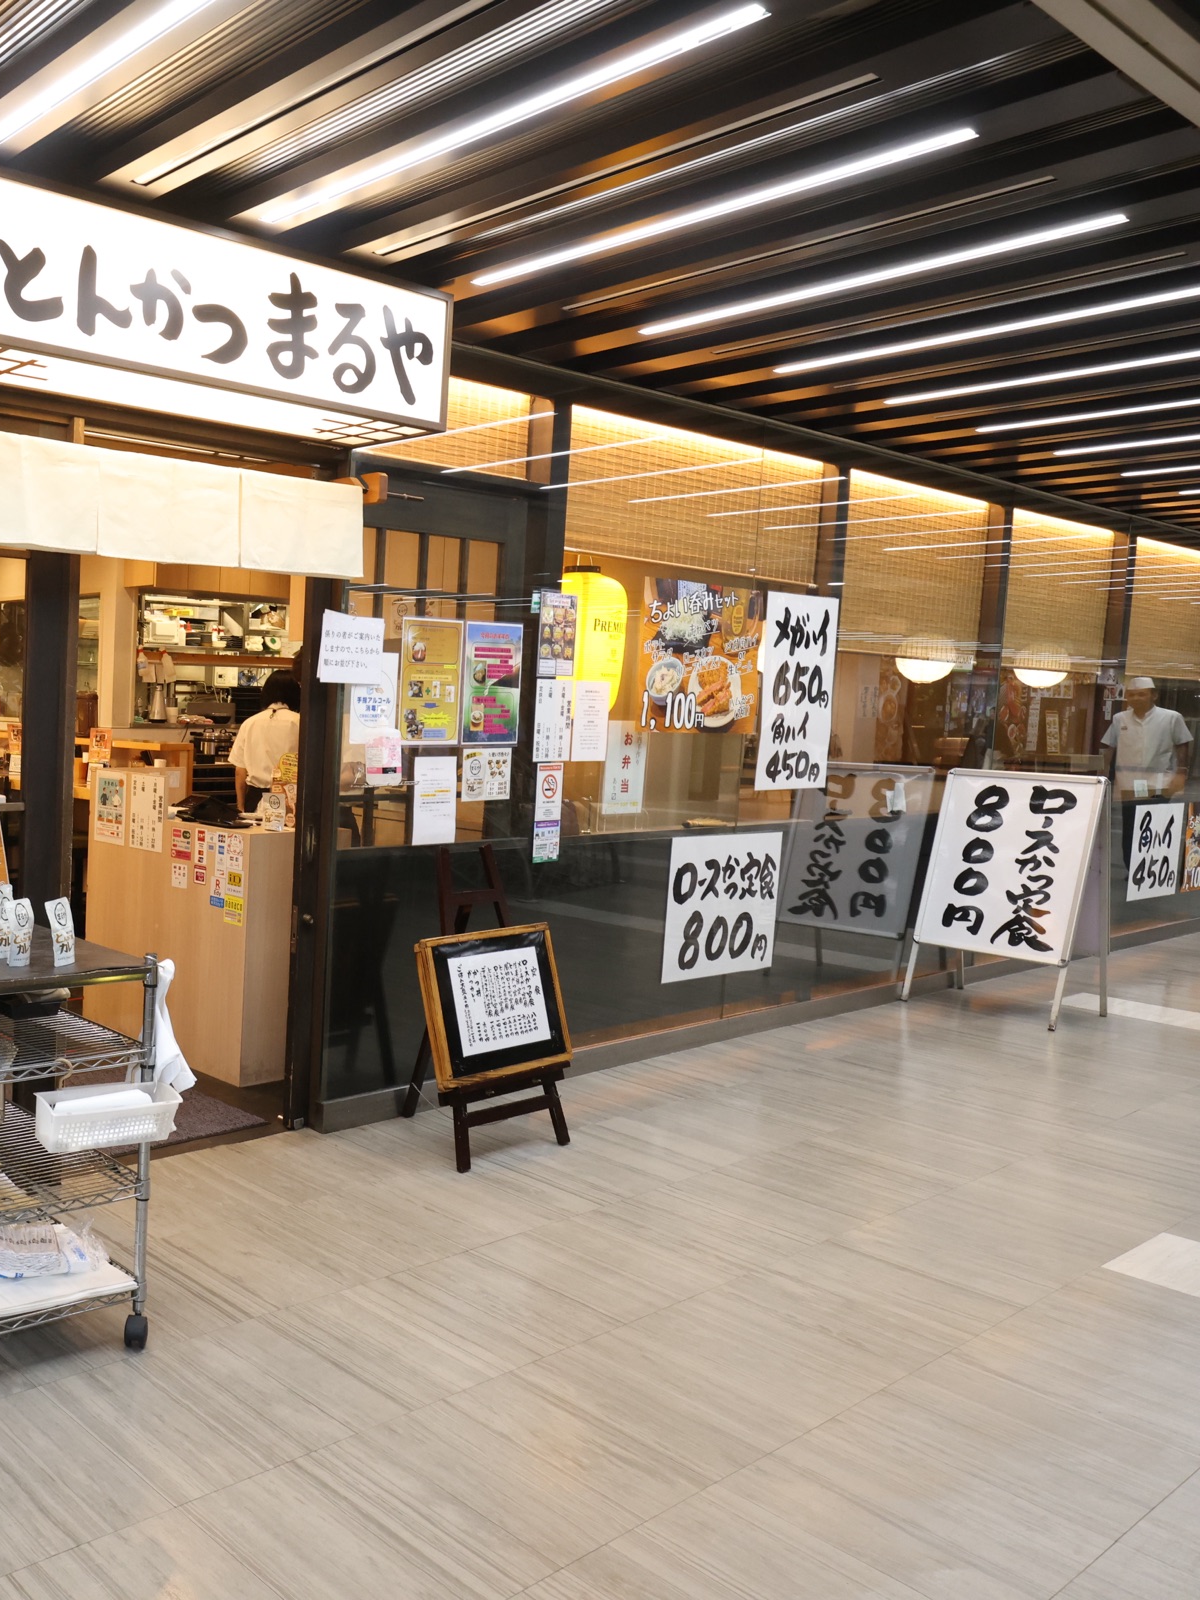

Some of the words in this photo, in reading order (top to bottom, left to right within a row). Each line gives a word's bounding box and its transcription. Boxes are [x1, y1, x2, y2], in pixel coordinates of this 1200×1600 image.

[649, 590, 739, 623] ちょい呑みセット
[324, 629, 381, 642] 係りの者がご案内いた
[324, 645, 380, 656] しますので、こちらから
[357, 696, 391, 705] 手指アルコール
[772, 662, 829, 709] 650円
[365, 705, 381, 713] 消毒
[641, 690, 704, 731] 1,100円
[771, 711, 809, 745] 角ハイ
[620, 731, 633, 793] お弁当
[765, 750, 820, 783] 450円
[1138, 810, 1175, 853] 角ハイ
[673, 851, 776, 906] ロースかつ定食
[941, 784, 1011, 935] 800円
[990, 784, 1078, 953] ロースかつ定食
[1132, 854, 1176, 892] 450円
[677, 911, 768, 971] 800円
